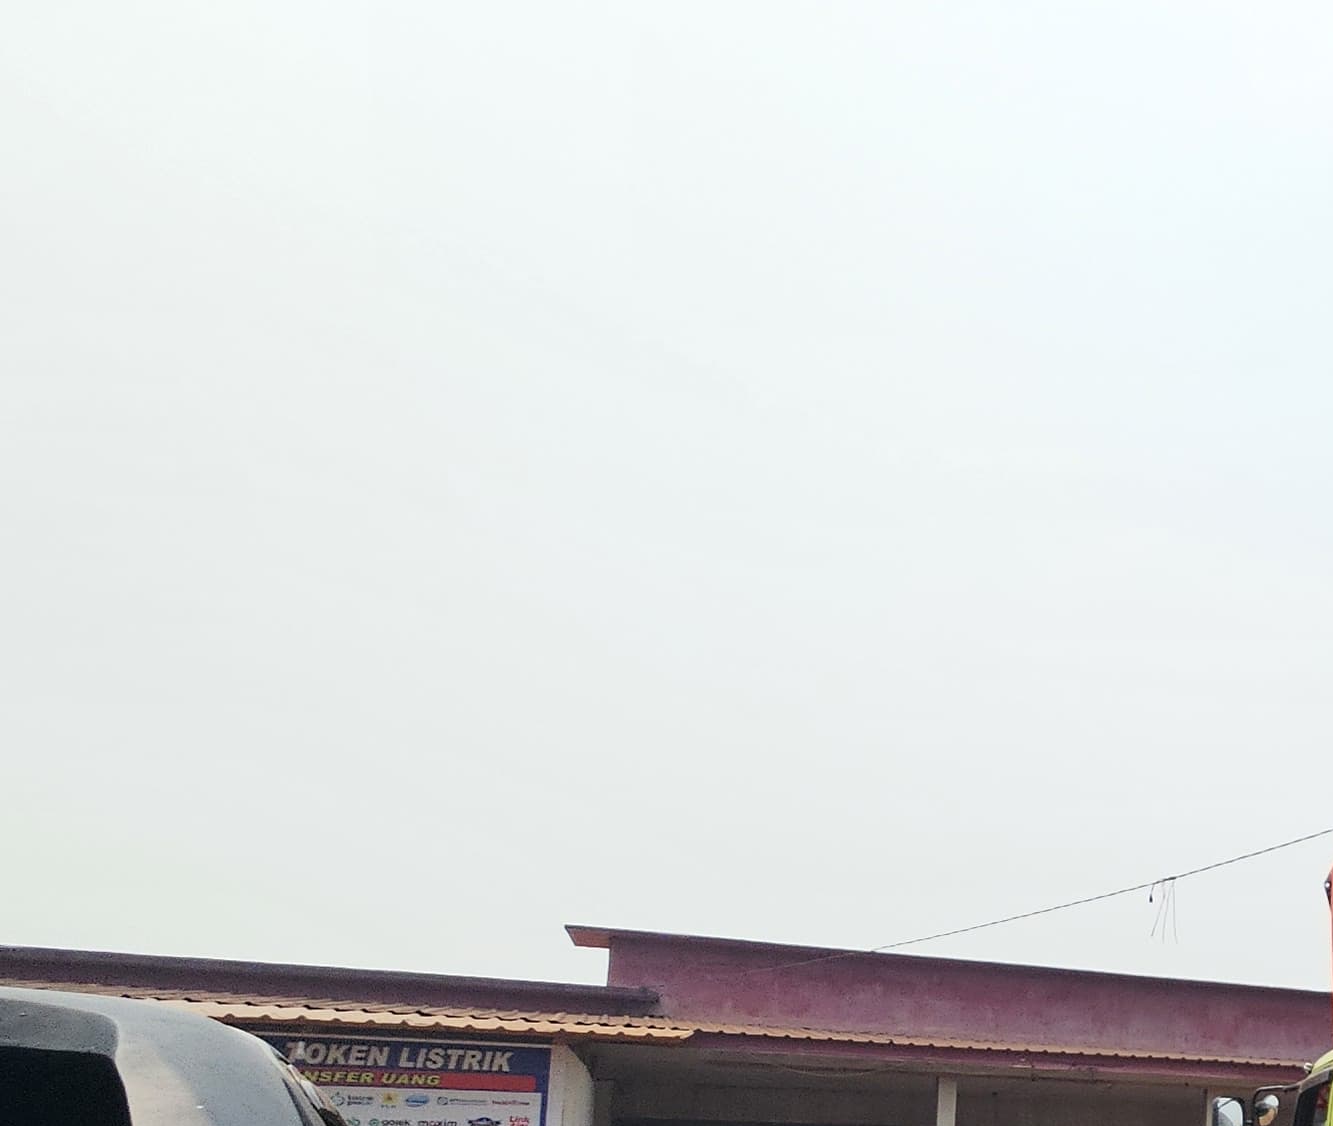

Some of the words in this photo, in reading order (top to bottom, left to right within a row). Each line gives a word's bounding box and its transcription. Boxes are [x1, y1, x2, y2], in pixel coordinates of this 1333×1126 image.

[399, 1047, 513, 1073] LISTRIK
[301, 1070, 375, 1084] NSFER
[383, 1072, 441, 1087] UANG
